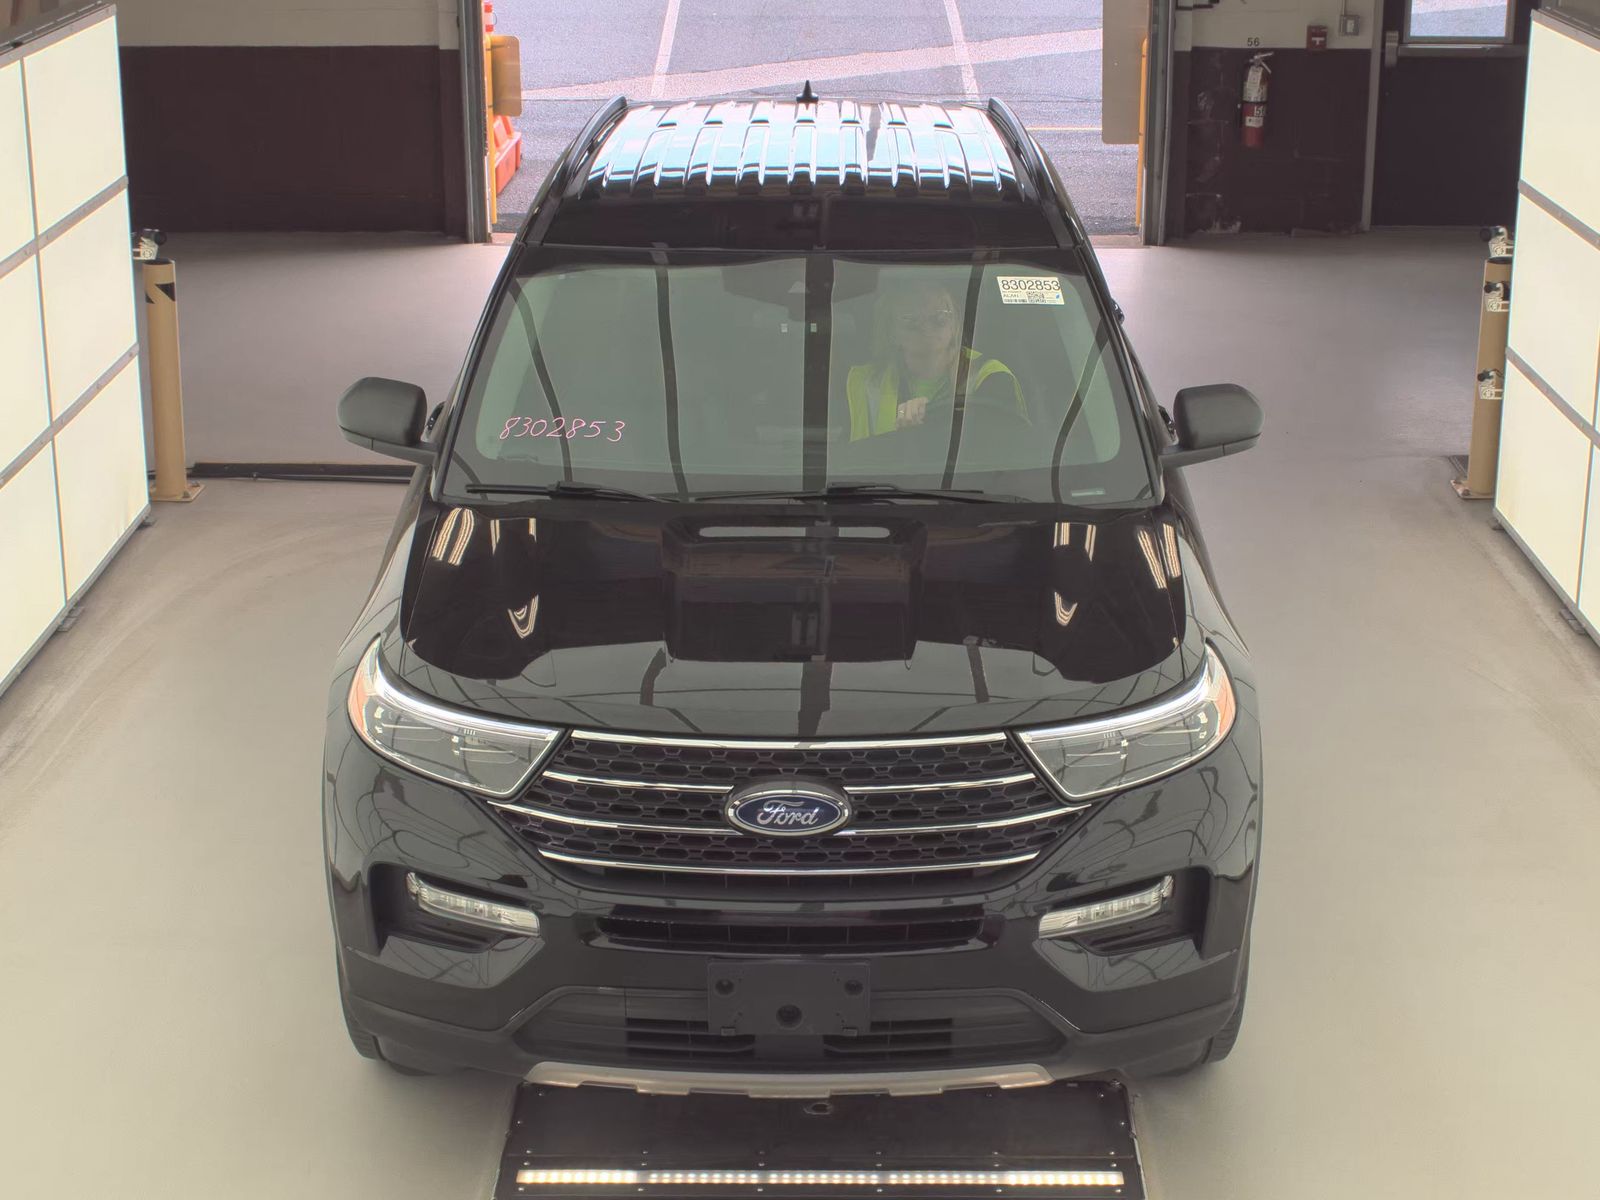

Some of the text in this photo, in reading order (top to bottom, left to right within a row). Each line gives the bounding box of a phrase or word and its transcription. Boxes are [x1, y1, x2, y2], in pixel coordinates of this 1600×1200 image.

[1247, 37, 1260, 47] 56
[1001, 279, 1062, 291] 8302853
[499, 416, 626, 442] 8302853
[756, 799, 820, 825] Ford
